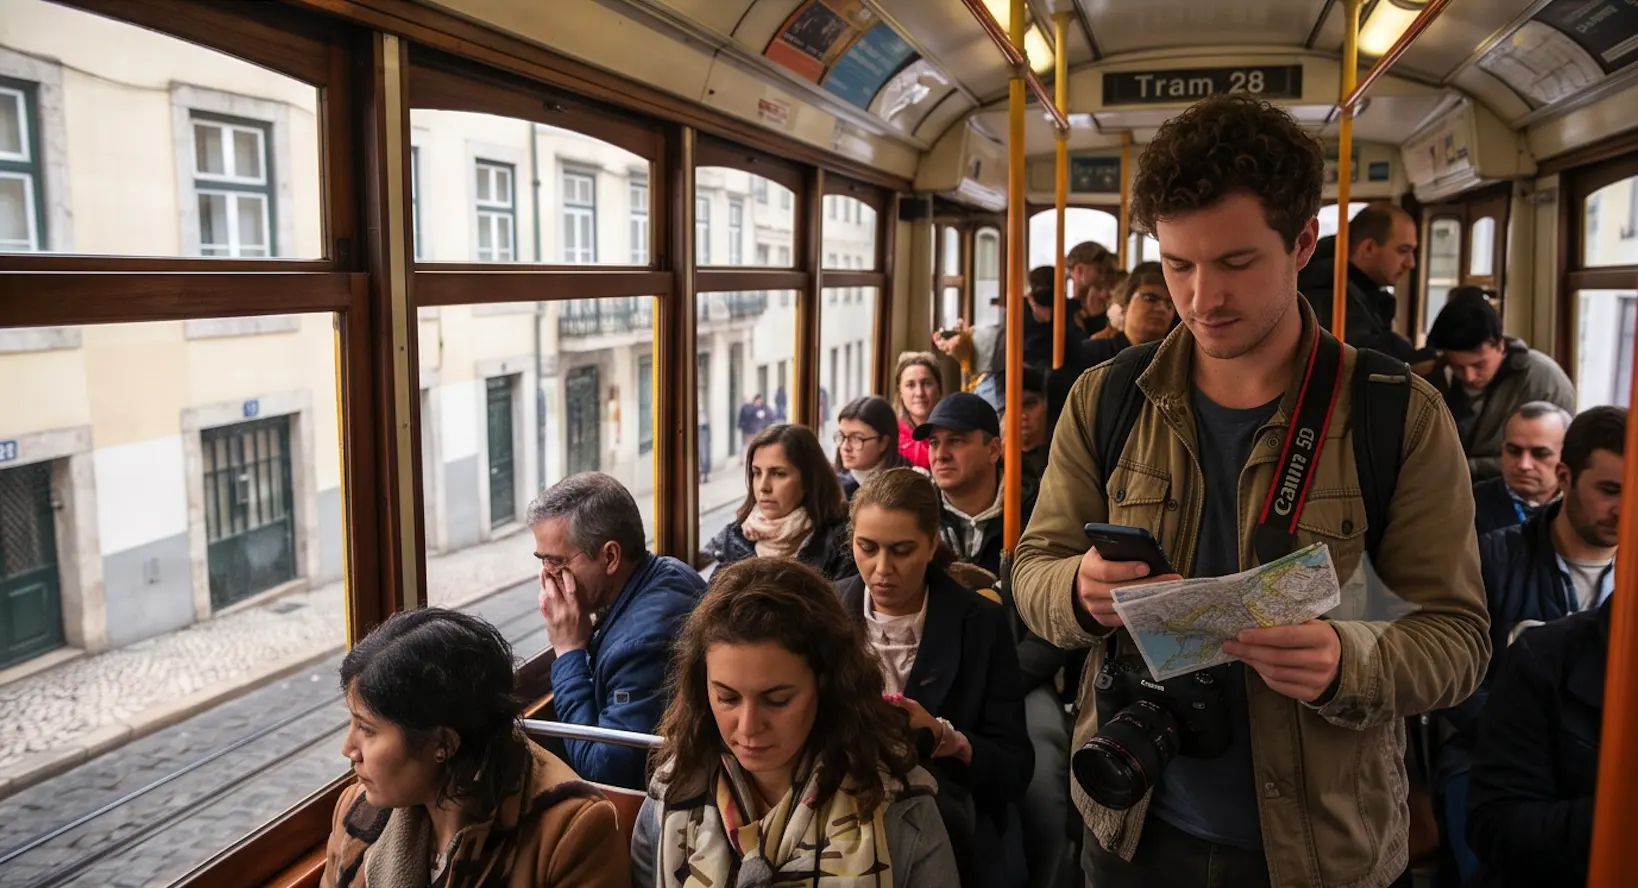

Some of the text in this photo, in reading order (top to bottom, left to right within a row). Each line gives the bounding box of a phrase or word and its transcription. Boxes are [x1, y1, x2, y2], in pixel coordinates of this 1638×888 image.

[1134, 71, 1265, 98] Tram 28
[1296, 427, 1315, 450] 5D
